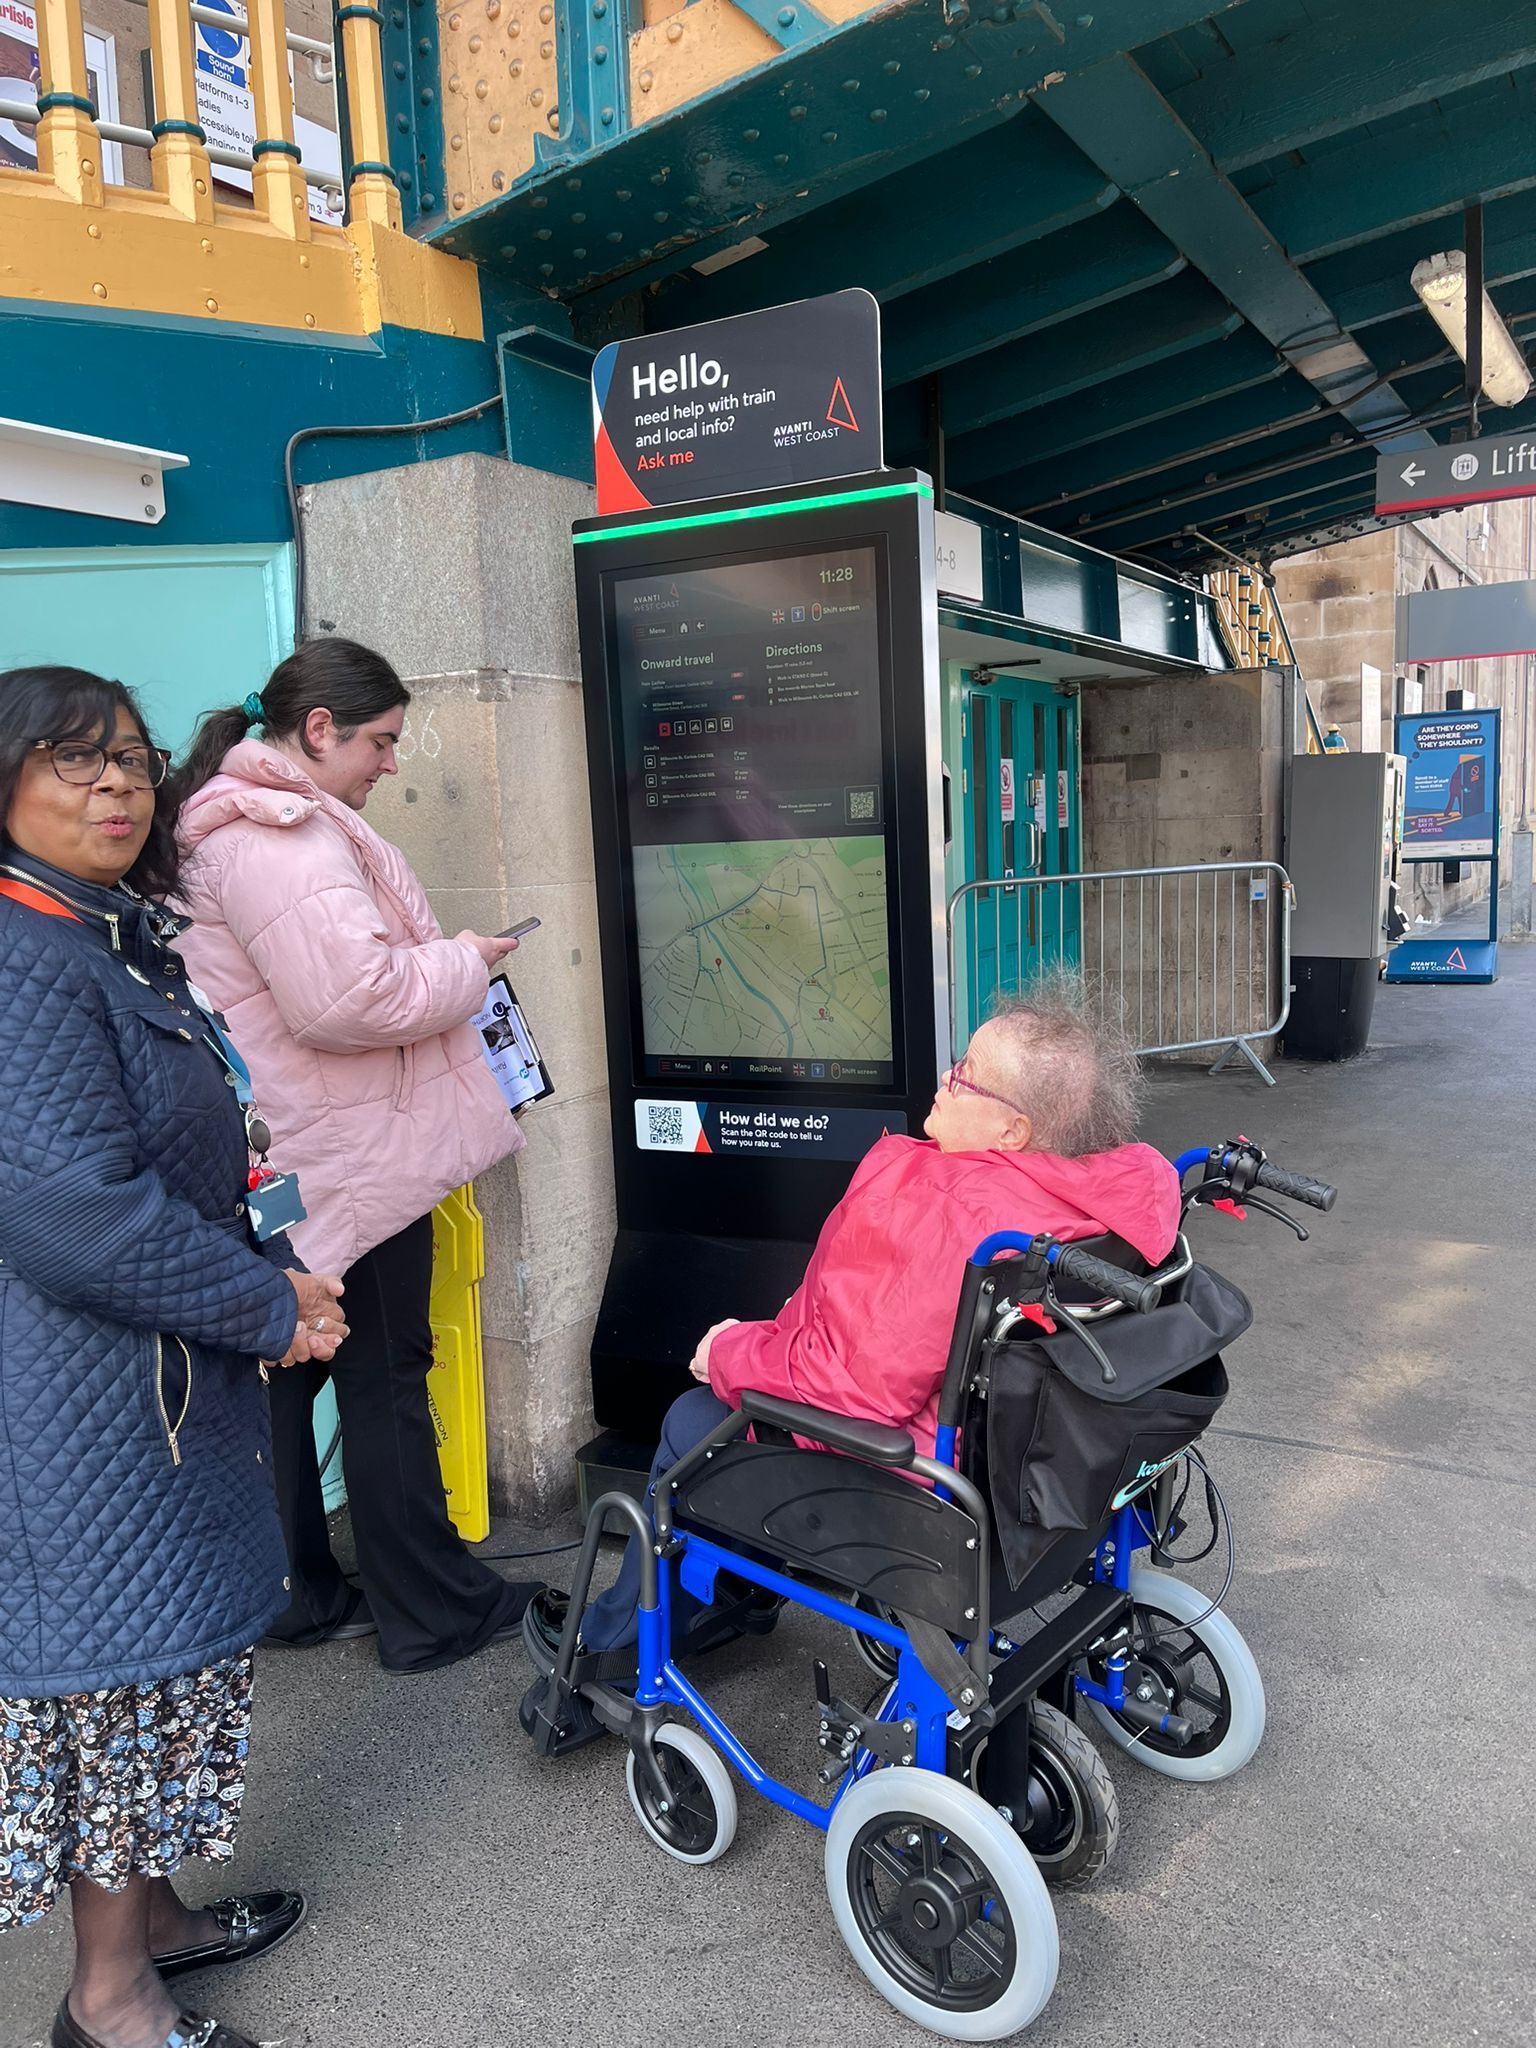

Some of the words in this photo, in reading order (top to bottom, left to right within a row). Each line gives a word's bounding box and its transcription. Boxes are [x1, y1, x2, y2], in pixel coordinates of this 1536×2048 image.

[208, 55, 235, 74] Sound
[212, 65, 232, 82] horn
[196, 78, 234, 102] latforms
[198, 97, 222, 114] adies
[200, 115, 240, 139] ccessible
[317, 203, 323, 215] 3
[632, 352, 730, 399] Hello,
[634, 406, 670, 427] need
[673, 399, 704, 422] help
[708, 393, 739, 413] with
[743, 387, 776, 407] train
[635, 427, 662, 448] and
[665, 421, 698, 442] local
[701, 416, 736, 437] info?
[773, 420, 813, 437] AVANTI
[774, 433, 803, 448] WEST
[805, 427, 841, 443] COAST
[637, 451, 665, 472] Ask
[669, 449, 694, 466] me
[819, 567, 854, 584] 11:28
[633, 594, 660, 604] AVANTI
[634, 601, 654, 612] WEST
[655, 600, 680, 610] COAST
[822, 605, 838, 616] Shift
[839, 603, 861, 613] screen
[649, 627, 666, 635] Menu
[765, 641, 823, 658] Directions
[640, 655, 682, 671] Onward
[684, 652, 714, 667] travel
[1455, 723, 1479, 731] GOING
[1417, 732, 1461, 741] SOMEWHERE
[1438, 738, 1483, 747] SHOULDN'T?
[674, 1062, 691, 1070] Menu
[749, 1064, 783, 1074] RailPoint
[841, 1067, 855, 1075] Shift
[719, 1111, 750, 1127] How
[753, 1112, 776, 1127] did
[780, 1117, 800, 1128] we
[804, 1115, 830, 1130] do?
[721, 1128, 739, 1137] Scan
[740, 1128, 753, 1138] the
[755, 1129, 768, 1139] QR
[769, 1130, 788, 1140] code
[789, 1132, 798, 1141] to
[800, 1131, 812, 1141] tell
[813, 1134, 823, 1142] us
[721, 1137, 738, 1147] how
[738, 1140, 753, 1149] you
[754, 1139, 769, 1148] rate
[770, 1141, 781, 1149] us.
[427, 1388, 449, 1441] TENTION
